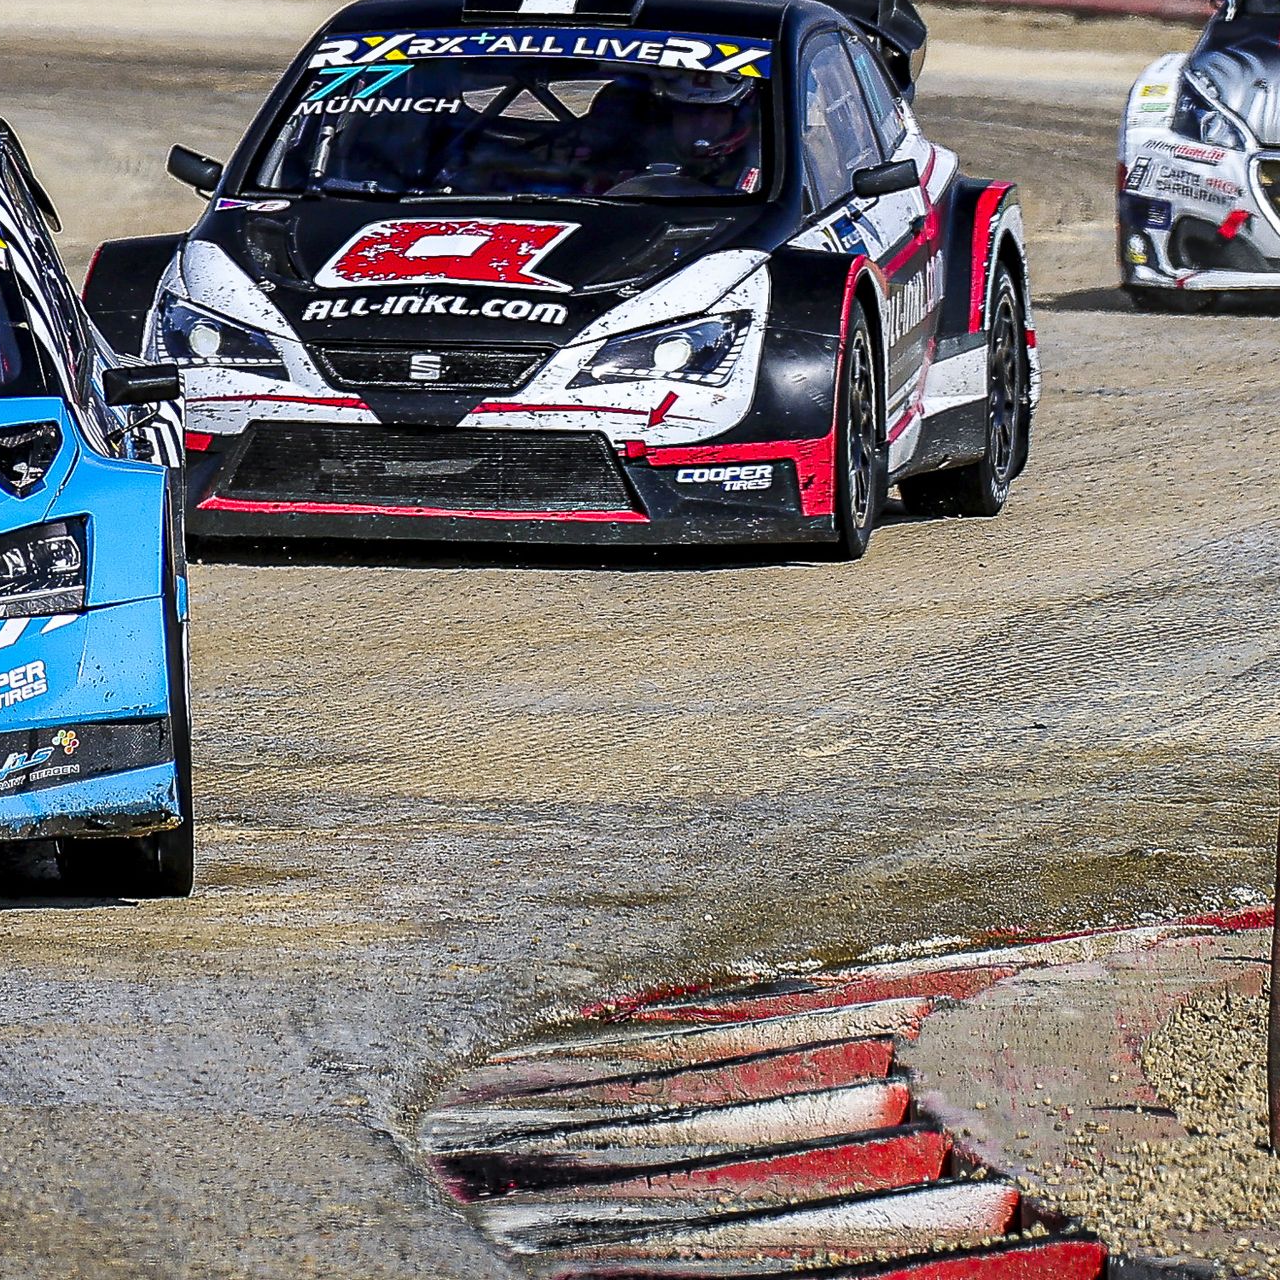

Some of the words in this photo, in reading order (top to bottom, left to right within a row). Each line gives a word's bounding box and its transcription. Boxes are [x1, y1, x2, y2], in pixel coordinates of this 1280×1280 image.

[487, 36, 563, 53] ALL
[573, 38, 663, 60] LIVE
[306, 64, 415, 100] 77
[292, 96, 460, 115] MÜNNICH
[676, 466, 773, 483] COOPER
[723, 479, 772, 491] TIRES
